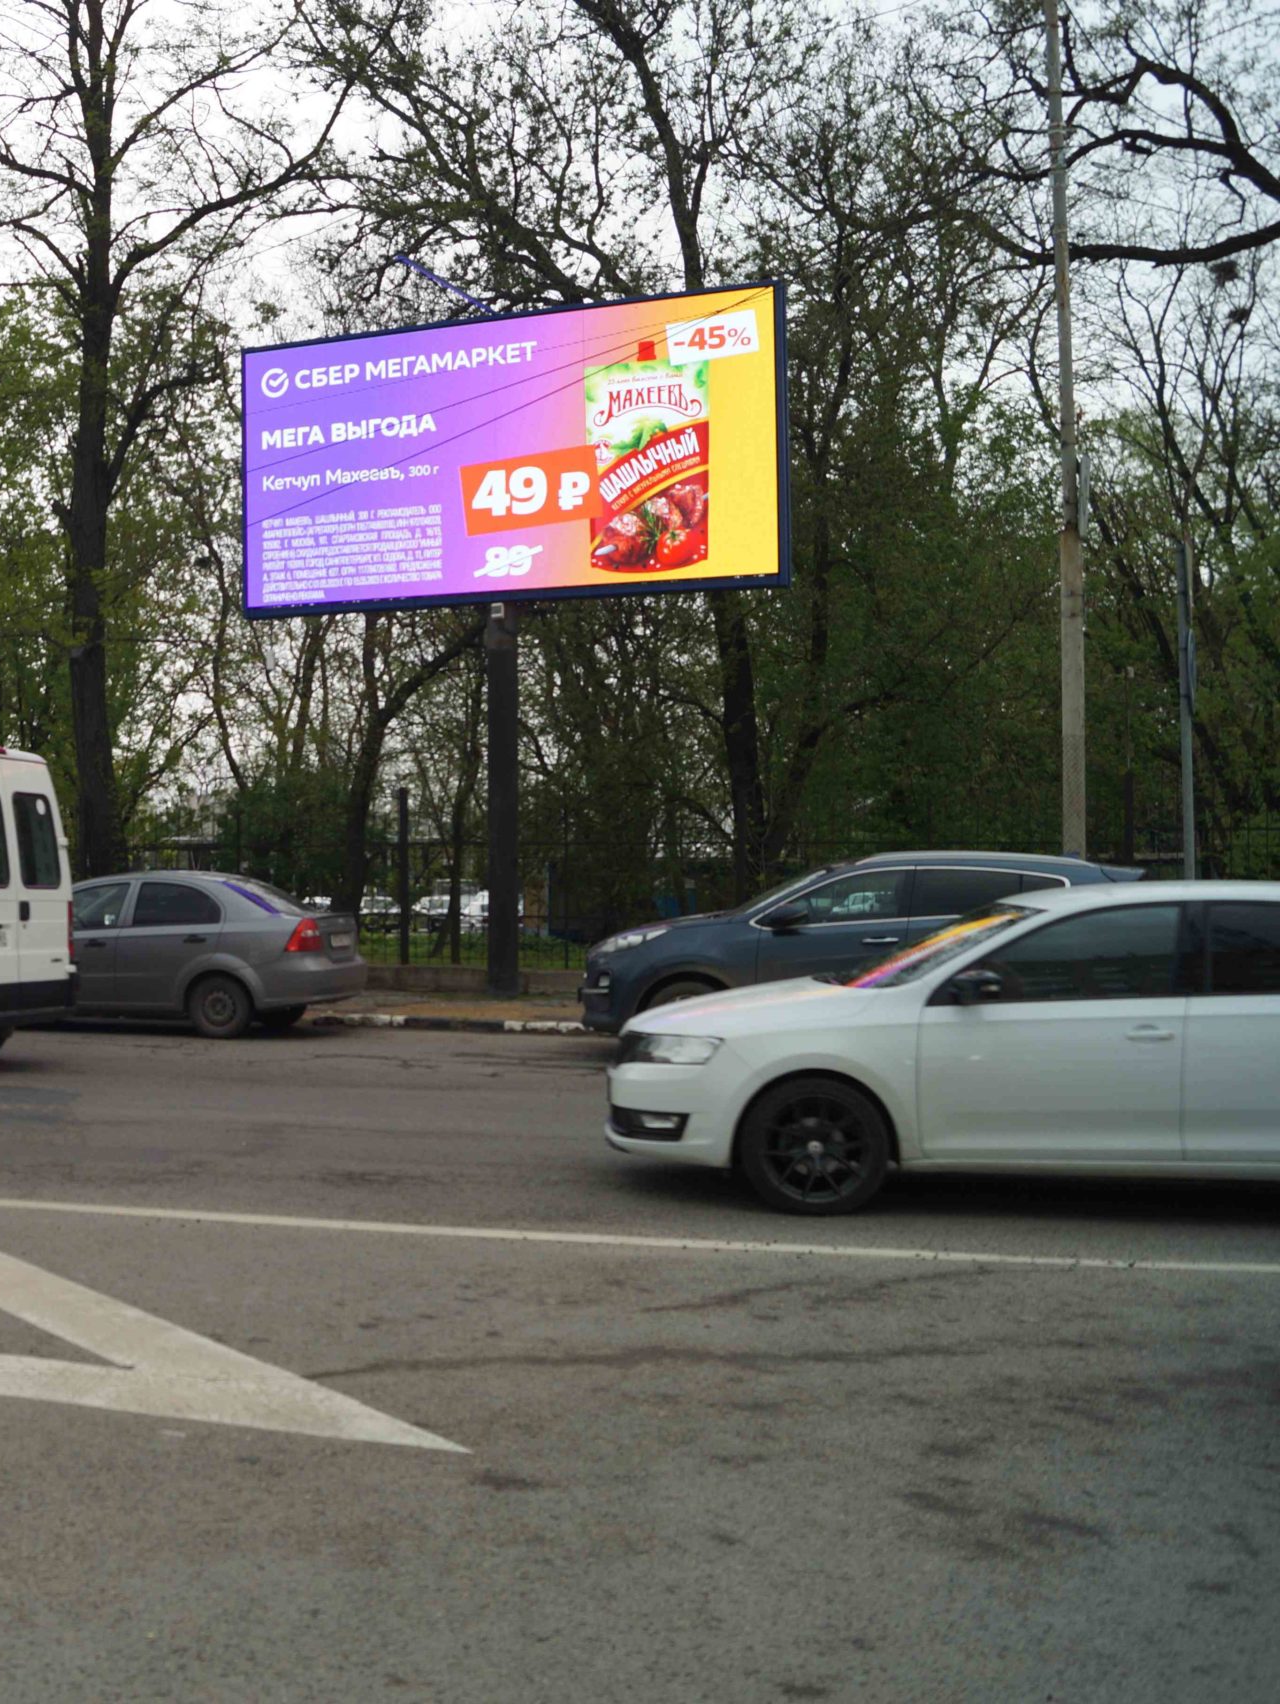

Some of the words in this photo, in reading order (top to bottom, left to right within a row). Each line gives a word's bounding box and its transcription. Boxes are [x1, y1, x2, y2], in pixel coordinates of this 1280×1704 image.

[294, 364, 360, 390] СБЕР
[365, 340, 538, 381] МЕГАМАРКЕТ
[261, 425, 325, 450] МЕГА
[331, 413, 437, 443] ВЫГОДА
[262, 473, 321, 492] Кетчуп
[325, 464, 405, 485] Махеевъ,
[408, 464, 431, 478] 300
[433, 465, 439, 475] г
[599, 428, 700, 503] ШАШЛЫЧНЫЙ
[471, 466, 548, 517] 49
[484, 545, 534, 577] 89
